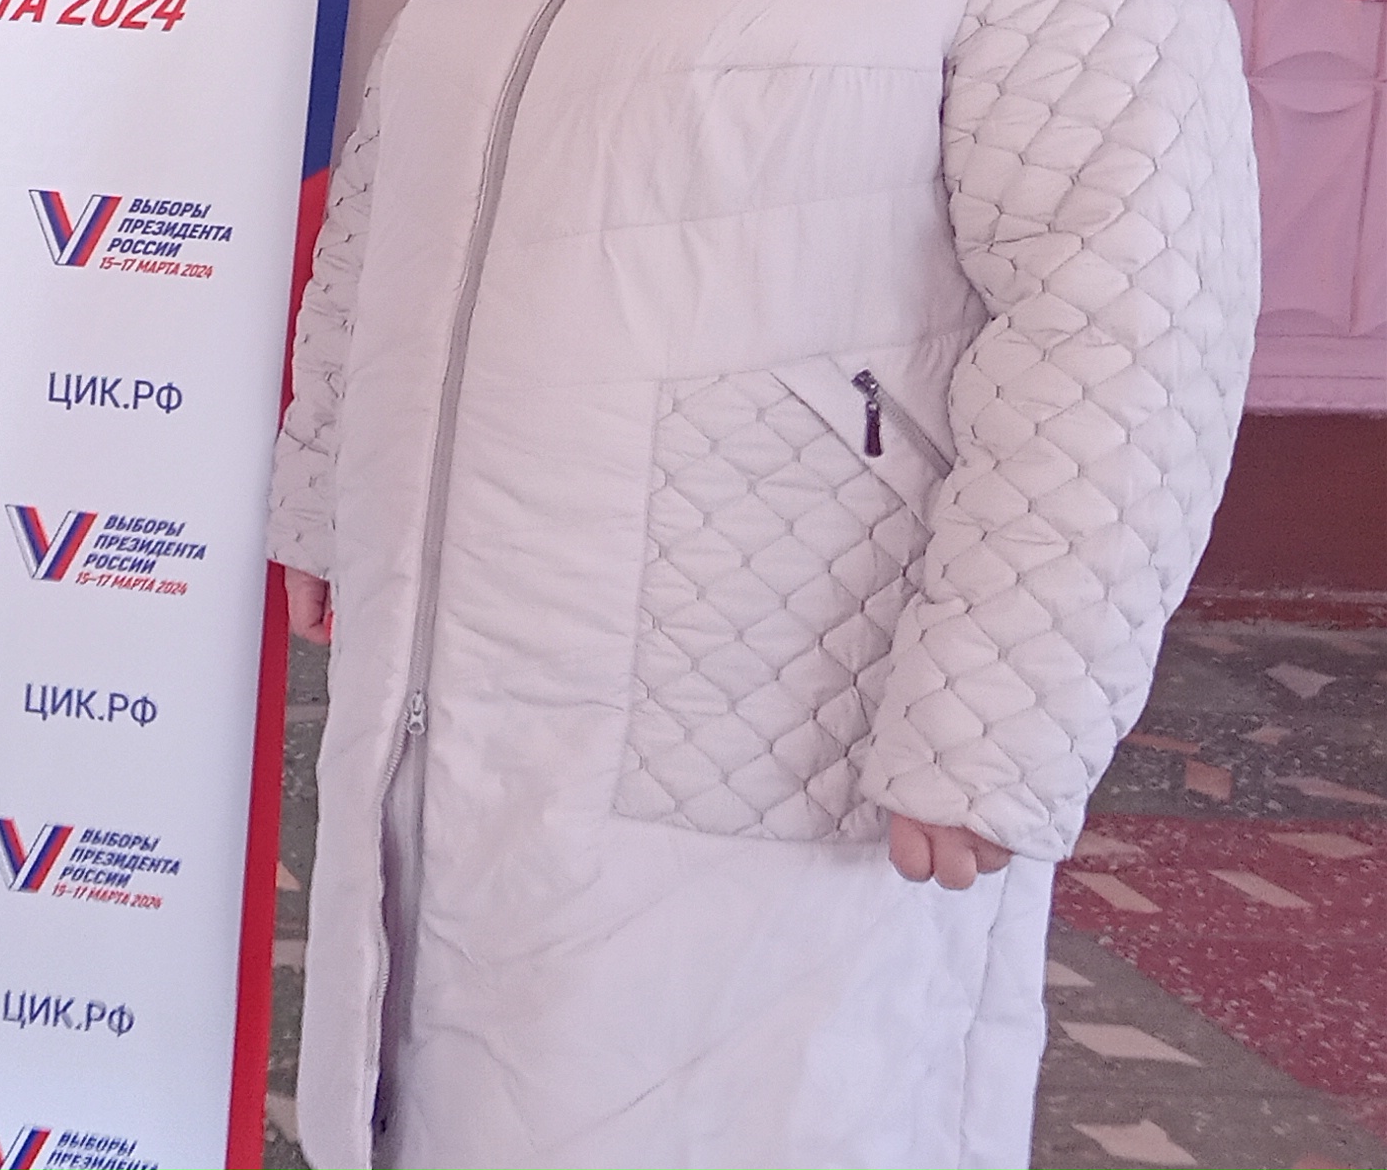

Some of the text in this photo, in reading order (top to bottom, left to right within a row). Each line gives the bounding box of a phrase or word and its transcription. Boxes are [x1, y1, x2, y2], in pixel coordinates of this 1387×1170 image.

[128, 198, 212, 218] ВЫБОРЫ
[117, 218, 234, 241] ПРЕЗИДЕНТА
[107, 238, 182, 257] РОССИИ
[134, 260, 180, 276] МАРТА
[180, 264, 214, 279] 2024
[48, 371, 183, 415] ЦИК.РФ
[103, 515, 186, 536] ВЫБОРЫ
[93, 534, 208, 559] ПРЕЗИДЕНТА
[83, 554, 156, 574] РОССИИ
[110, 576, 155, 592] МАРТА
[155, 581, 188, 595] 2024
[24, 683, 158, 728] ЦИК.РФ
[79, 829, 159, 851] ВЫБОРЫ
[69, 848, 181, 874] ПРЕЗИДЕНТА
[59, 866, 131, 887] РОССИИ
[85, 888, 129, 905] МАРТА
[129, 895, 162, 909] 2024
[2, 989, 134, 1038] ЦИК.РФ
